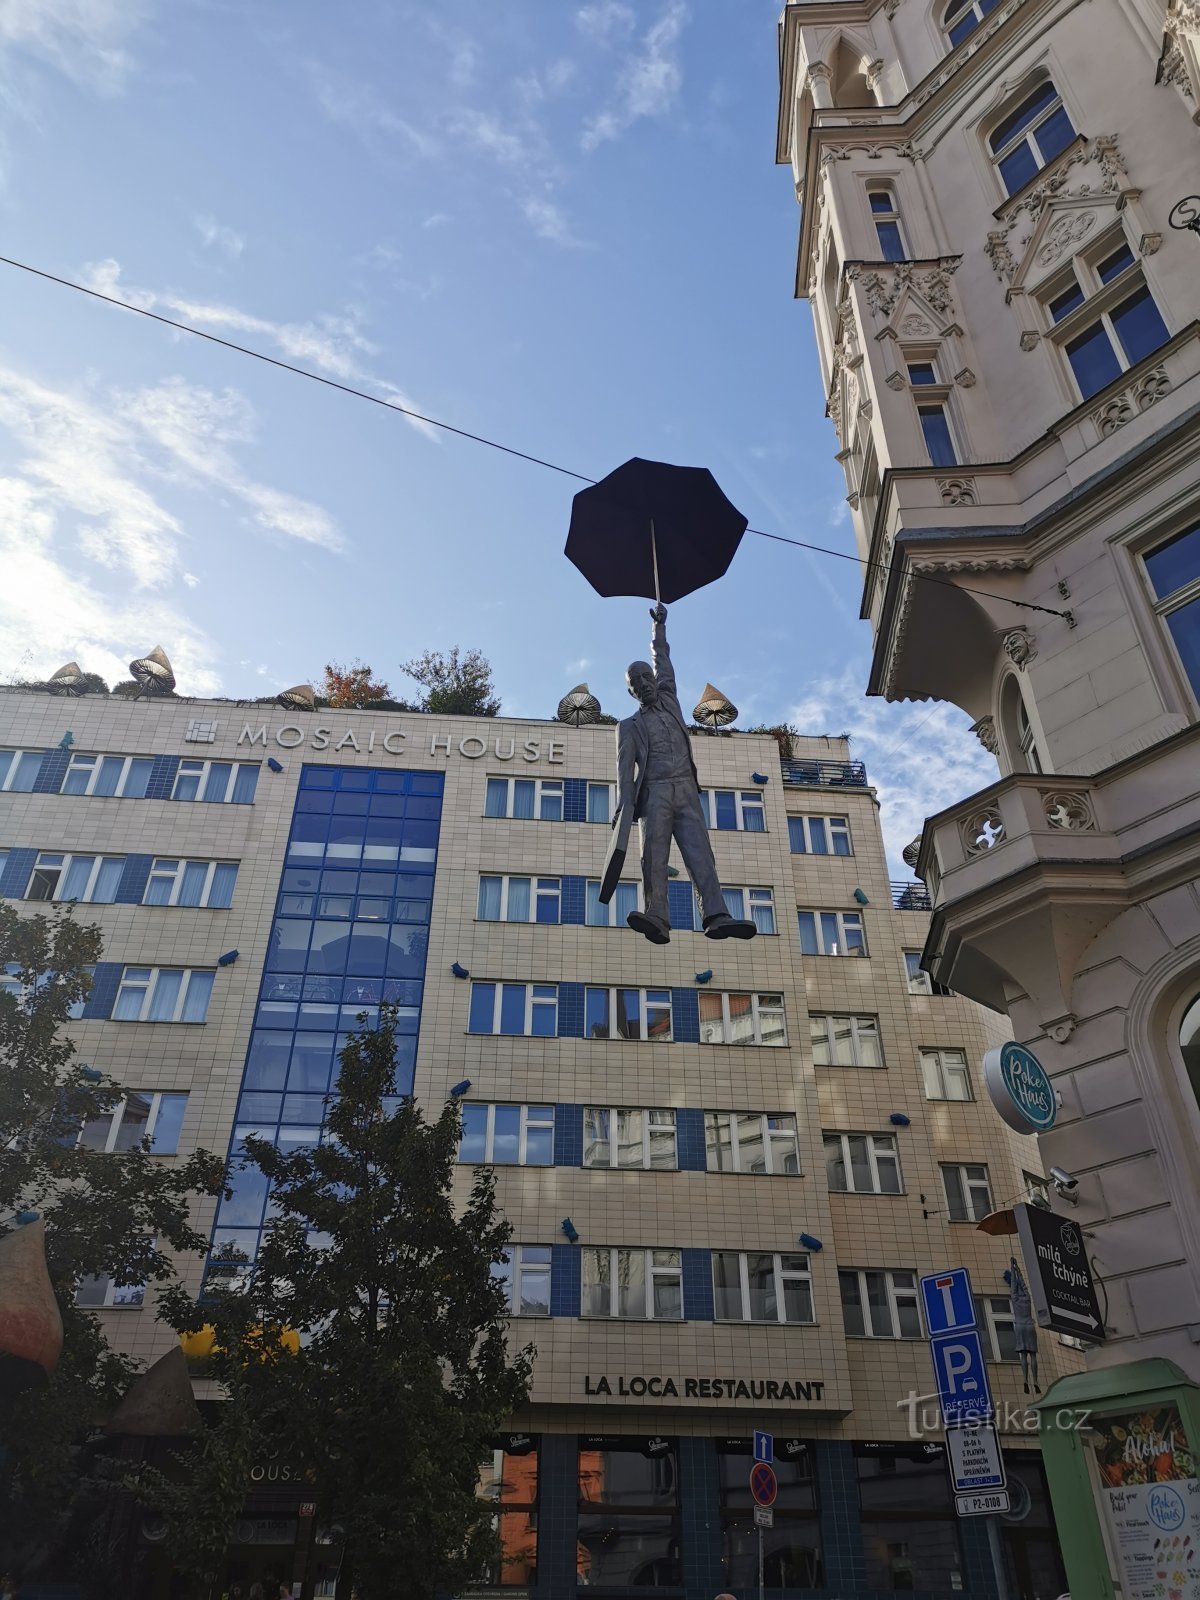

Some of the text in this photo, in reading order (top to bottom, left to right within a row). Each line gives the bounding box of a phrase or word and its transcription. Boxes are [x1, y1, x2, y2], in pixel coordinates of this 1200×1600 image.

[237, 721, 566, 765] MOSAIC HOUSE
[1016, 1078, 1049, 1112] Haus
[1037, 1243, 1062, 1264] milá
[1052, 1262, 1089, 1288] tchýně
[1052, 1288, 1092, 1308] COCKTAIL BAR
[943, 1344, 972, 1394] P
[585, 1375, 825, 1401] LA LOCA RESTAURANT
[945, 1394, 987, 1412] RÉSERVÉ
[973, 1497, 1001, 1509] P2-0108
[1156, 1507, 1181, 1524] Haus
